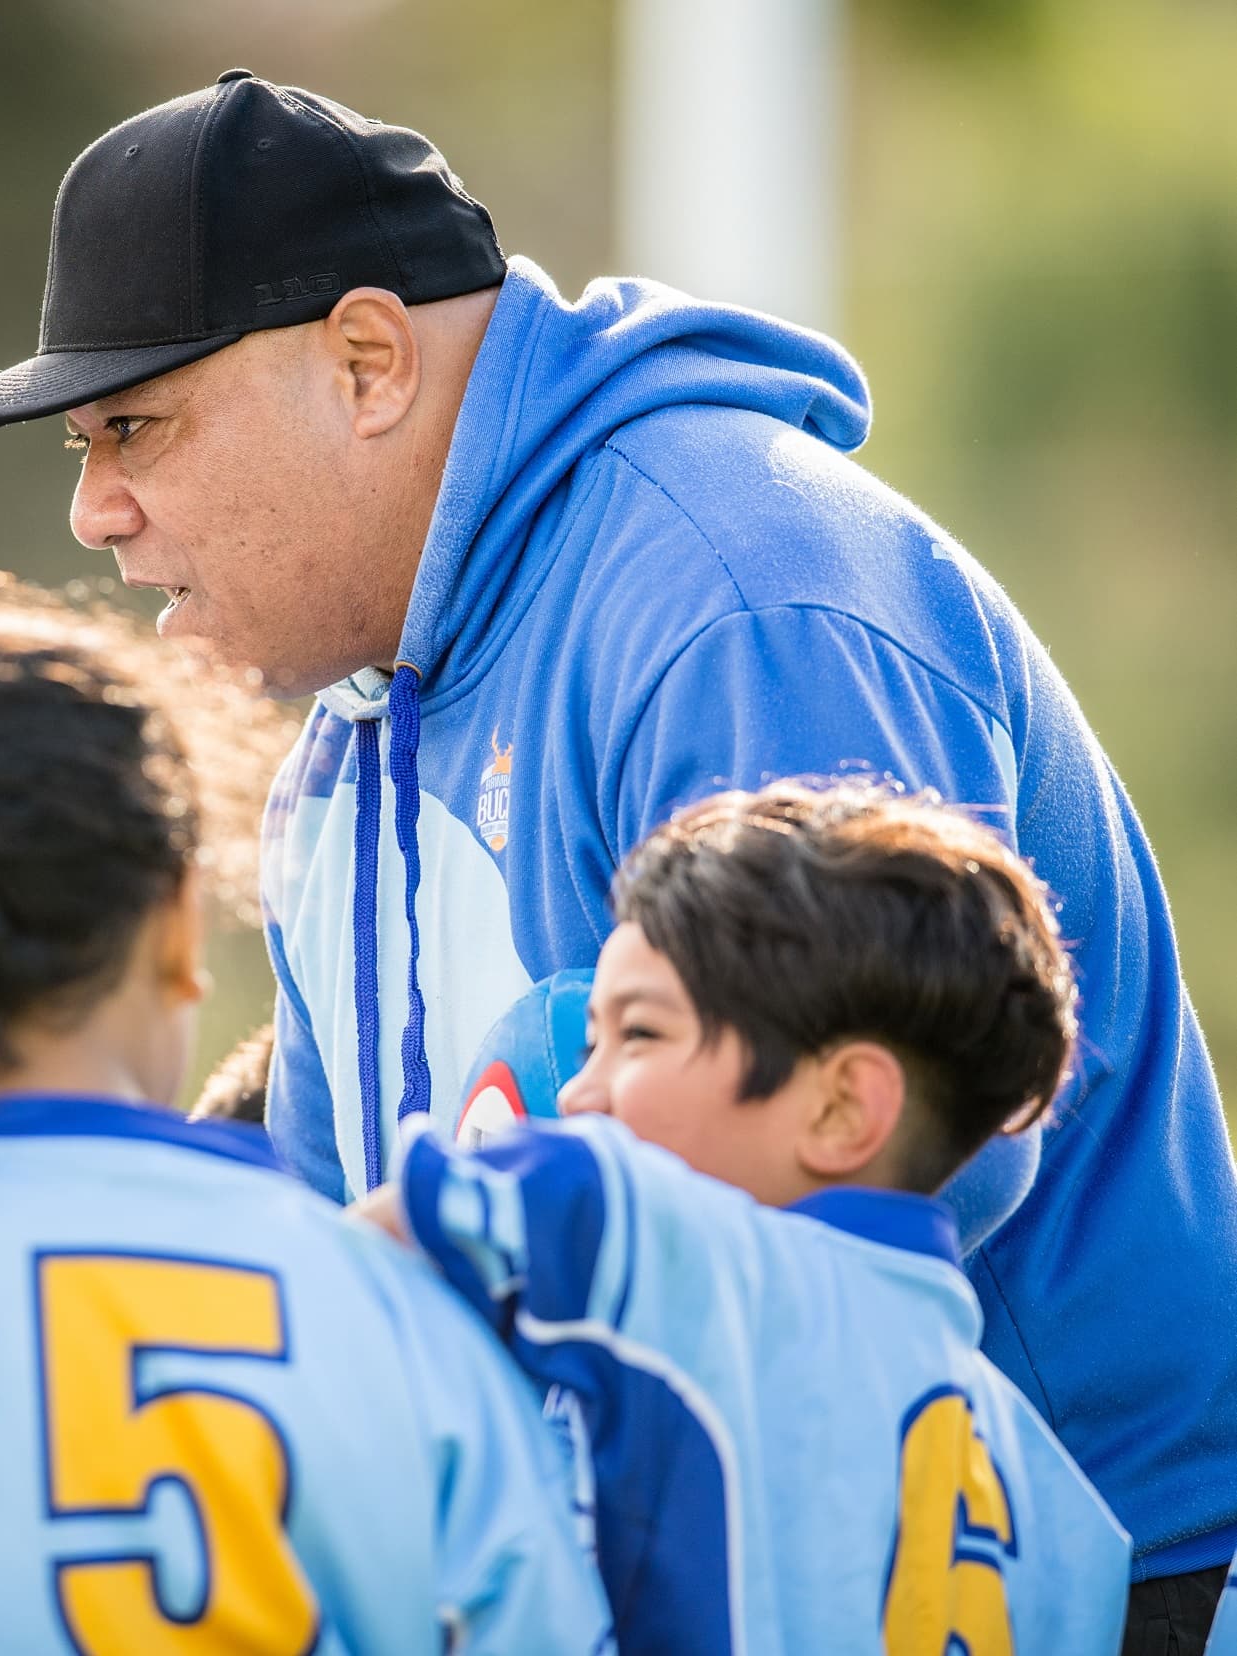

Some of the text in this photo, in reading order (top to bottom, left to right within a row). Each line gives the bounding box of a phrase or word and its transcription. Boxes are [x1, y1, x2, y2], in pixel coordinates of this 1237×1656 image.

[477, 788, 510, 827] BUC
[31, 1247, 322, 1656] 5
[878, 1383, 1019, 1656] 6
